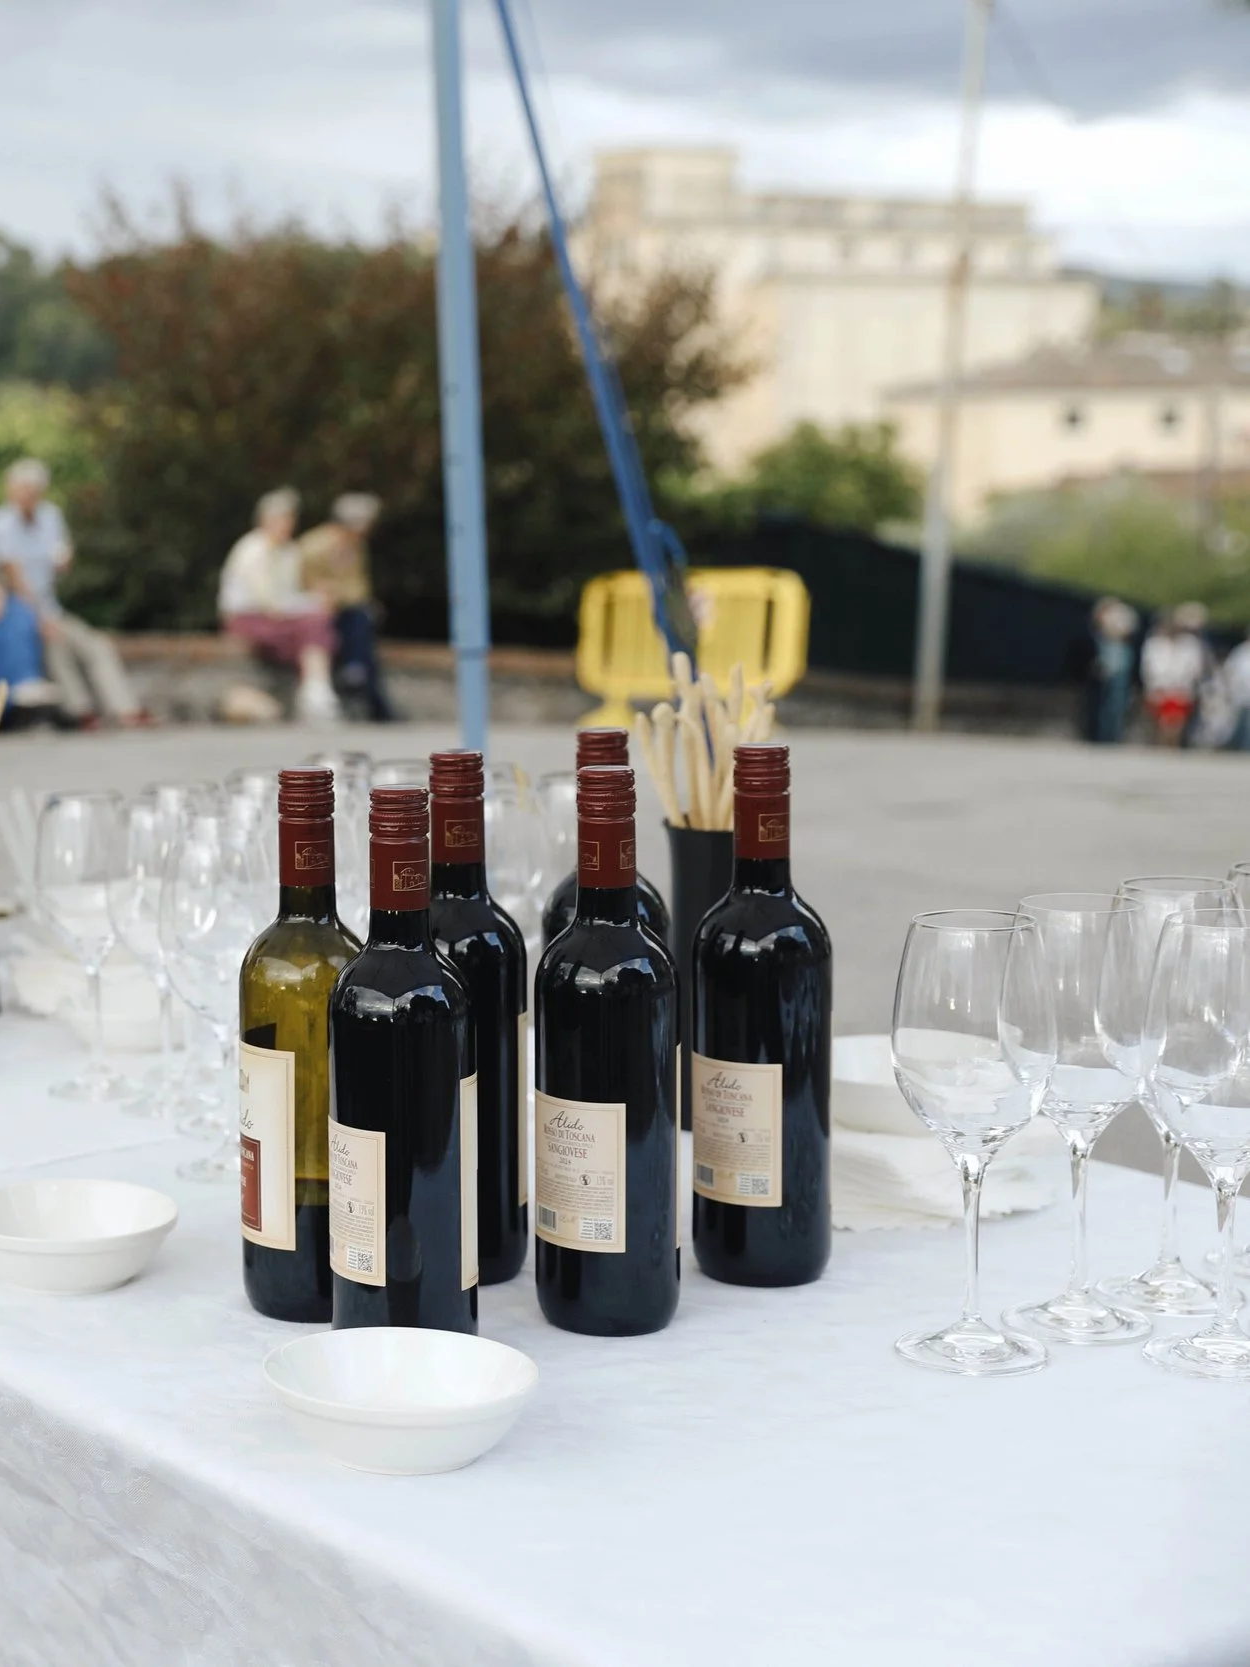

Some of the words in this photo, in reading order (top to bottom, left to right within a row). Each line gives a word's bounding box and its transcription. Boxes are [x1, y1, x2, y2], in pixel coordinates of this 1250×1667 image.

[549, 1110, 585, 1131] Alido
[565, 1130, 596, 1143] TOSCANA
[547, 1142, 588, 1159] SANGIOVESE
